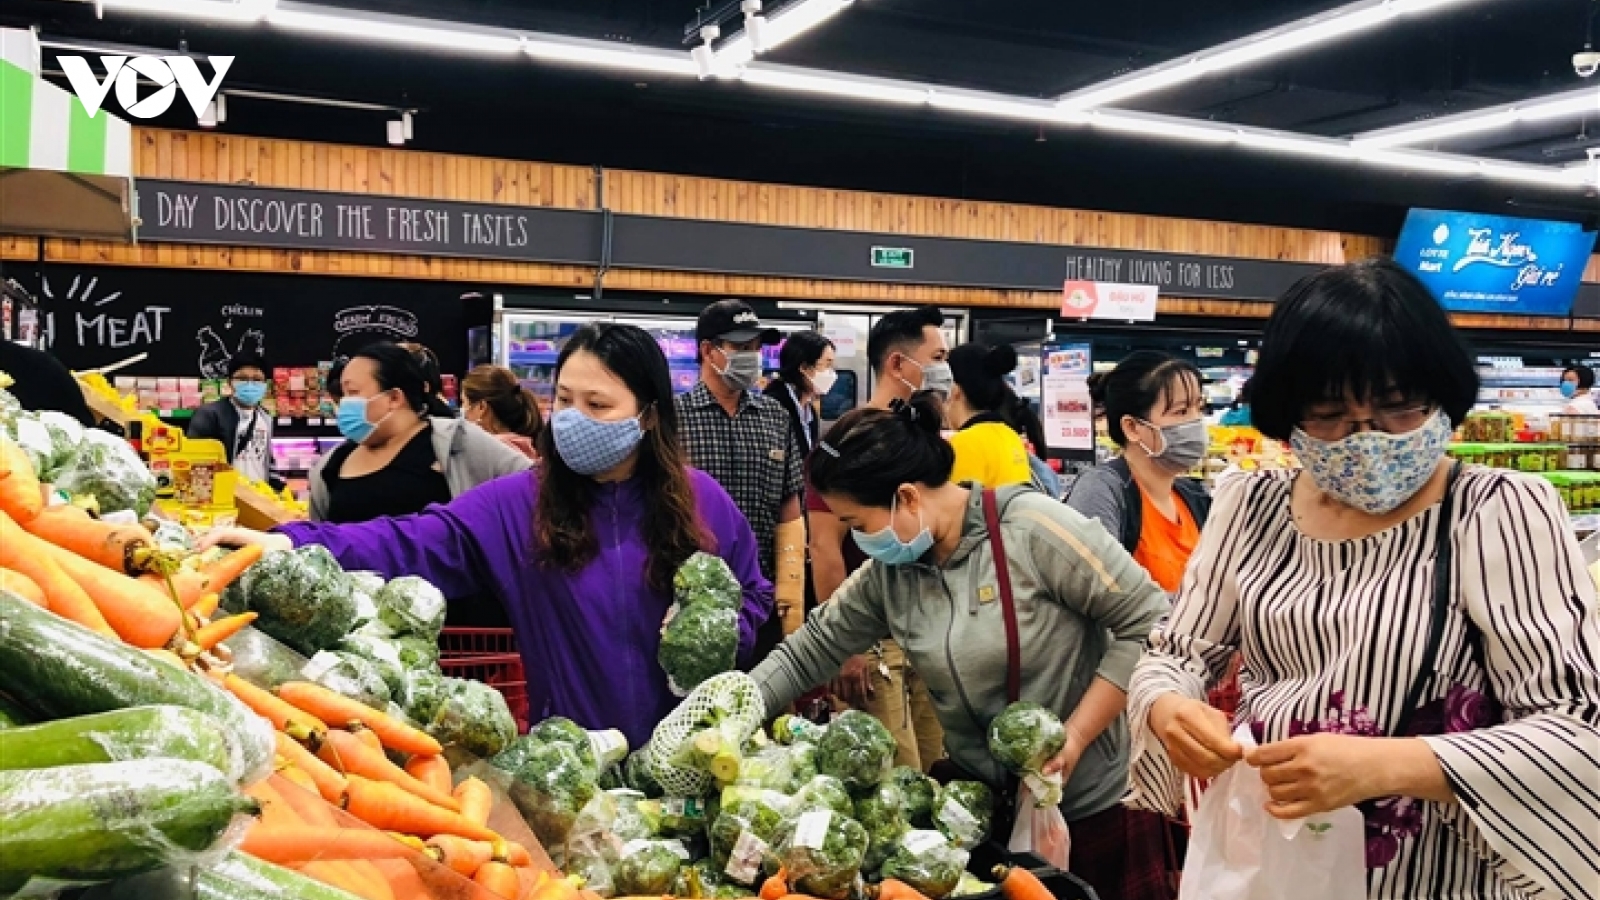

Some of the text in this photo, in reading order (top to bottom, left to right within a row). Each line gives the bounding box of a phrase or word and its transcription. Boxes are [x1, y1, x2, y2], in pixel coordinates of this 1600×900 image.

[157, 191, 198, 229] DAY
[214, 196, 323, 237] DISCOVER
[336, 205, 376, 240] THE
[386, 207, 450, 244] FRESH
[462, 211, 528, 247] TASTES
[1066, 256, 1234, 289] HEALTHY LIVING FOR LESS
[75, 305, 172, 348] MEAT
